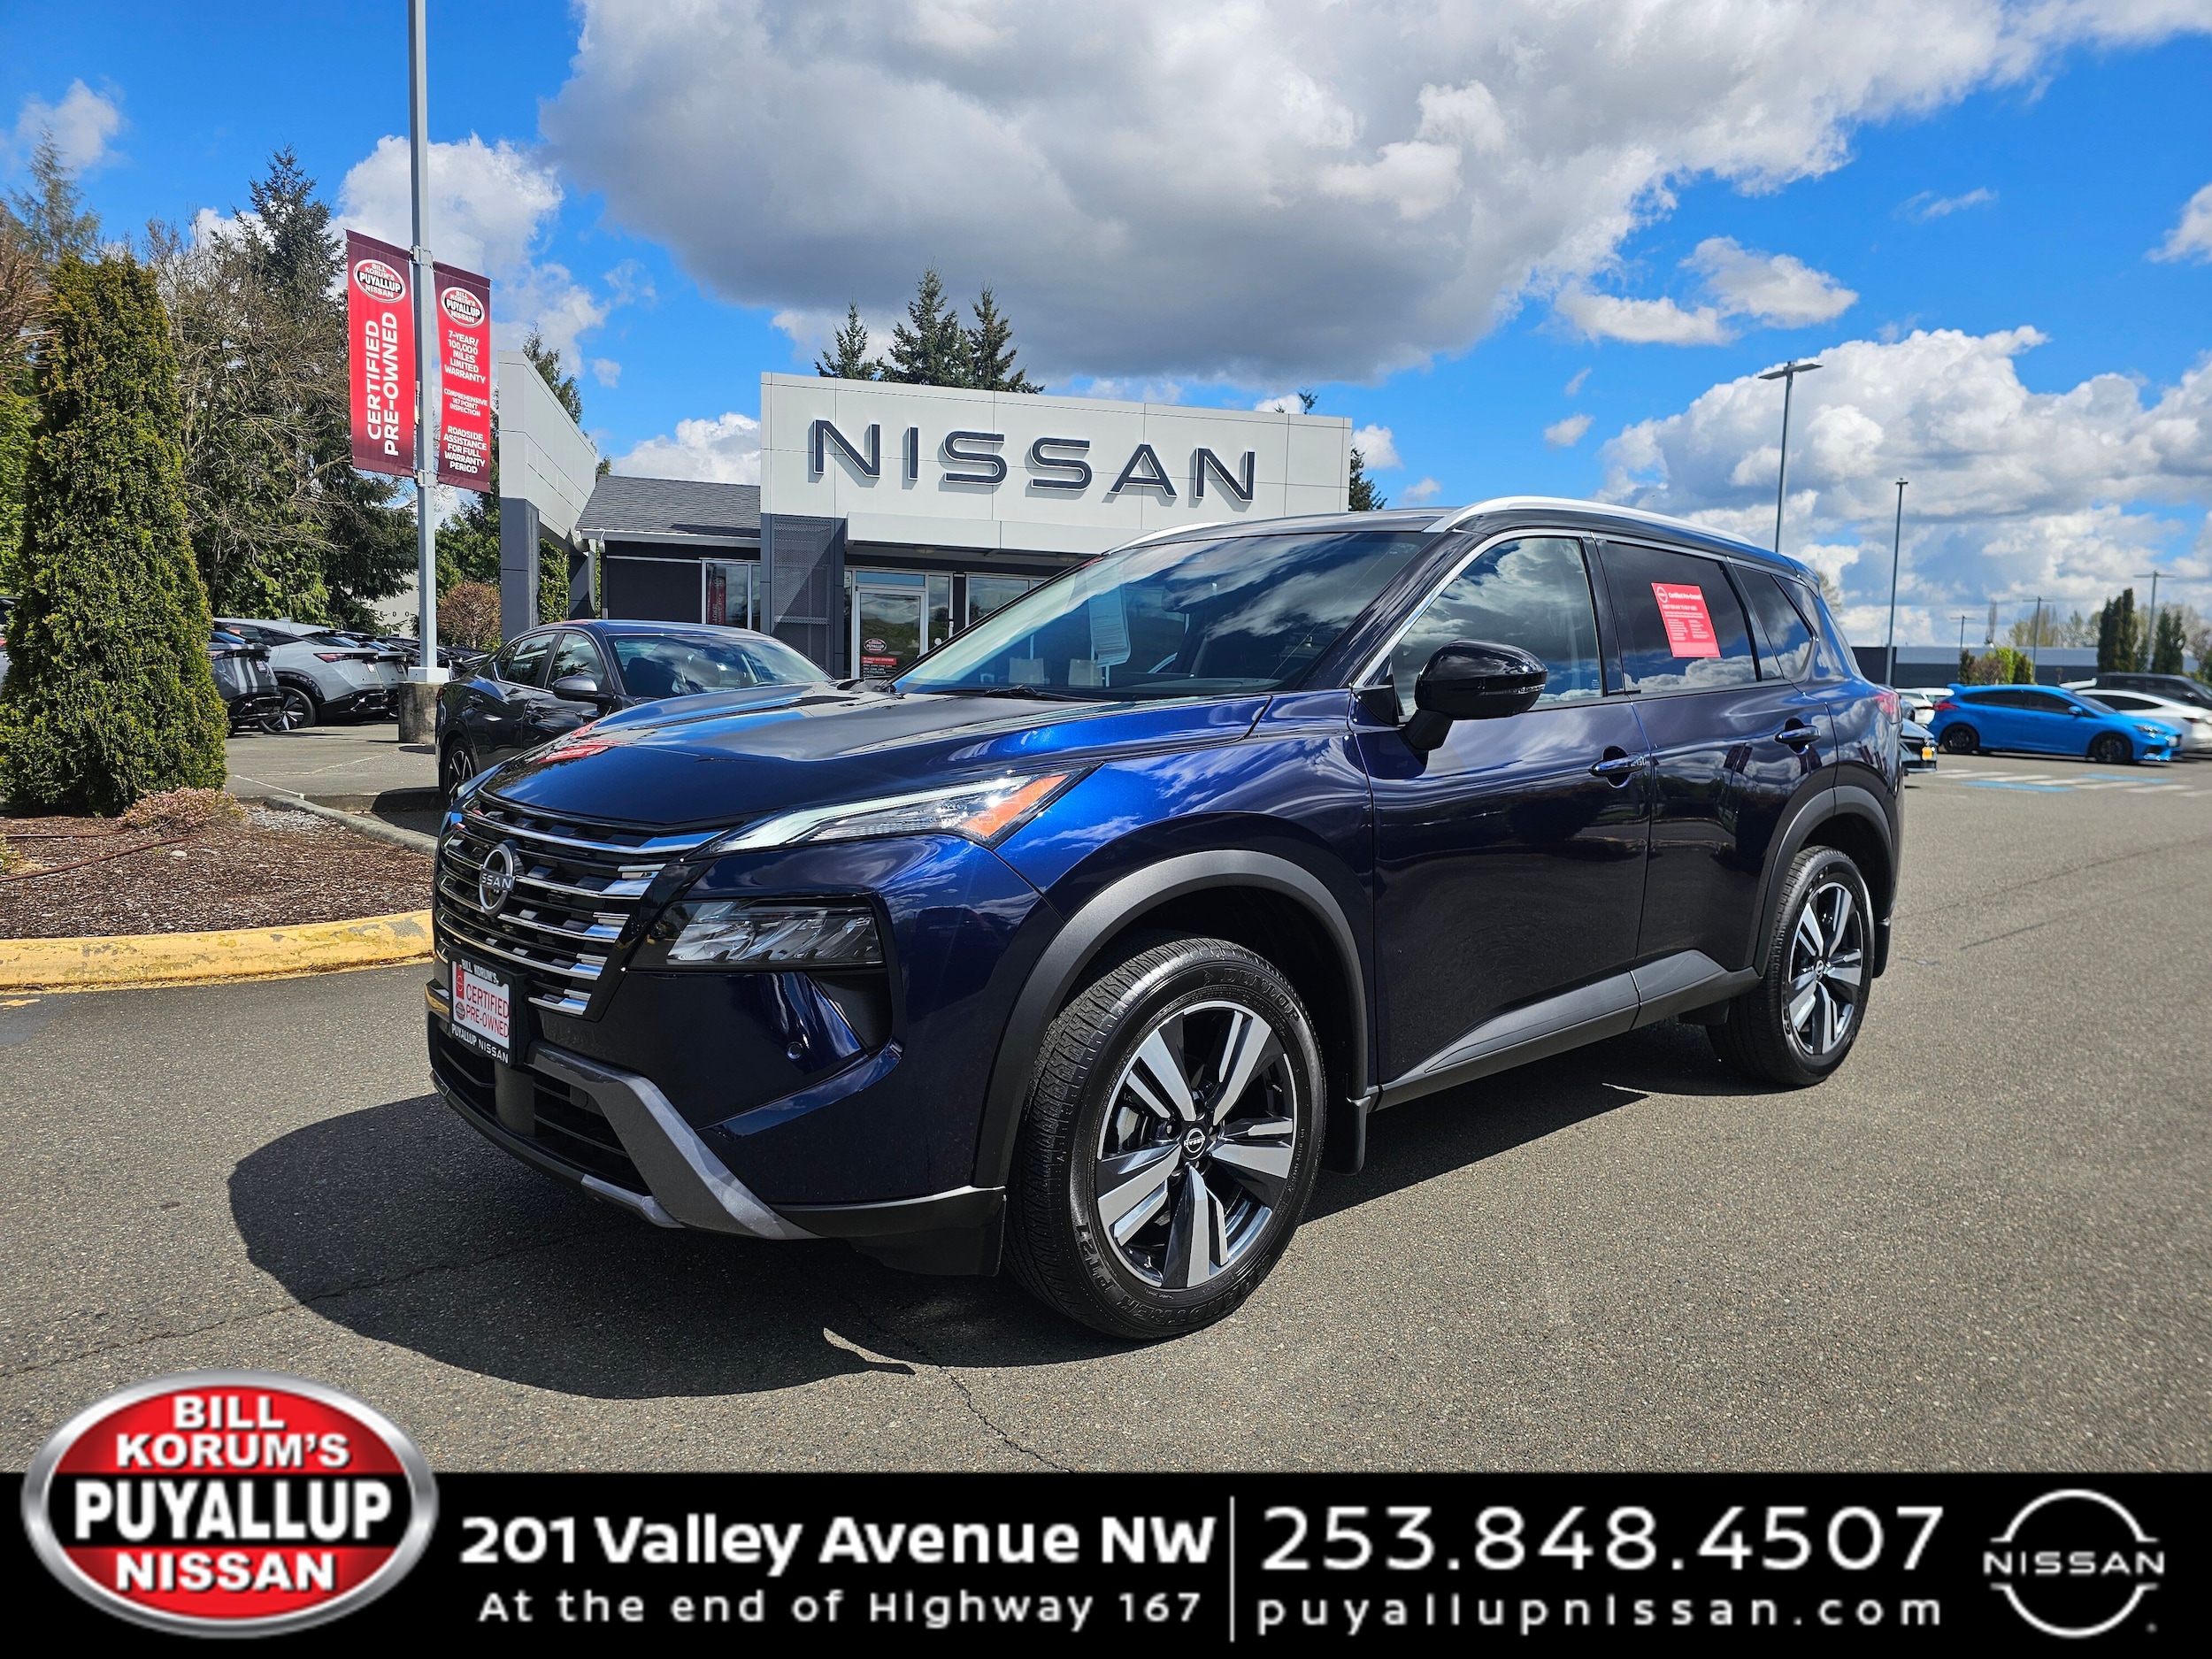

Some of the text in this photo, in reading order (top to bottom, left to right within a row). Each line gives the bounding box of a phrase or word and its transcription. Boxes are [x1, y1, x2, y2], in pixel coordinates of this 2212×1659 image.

[365, 266, 395, 280] KORUM'S
[372, 263, 387, 273] BILL
[359, 272, 402, 292] PUYALLUP
[365, 284, 394, 298] NISSAN
[456, 290, 469, 299] BILL
[449, 294, 476, 306] KORUM'S
[446, 299, 480, 318] PUYALLUP
[450, 311, 475, 323] NISSAN
[448, 330, 479, 347] 7-YEAR/
[448, 339, 479, 355] 100,000
[453, 349, 475, 364] MILES
[449, 357, 479, 373] LIMITED
[365, 320, 381, 441] CERTIFIED
[444, 365, 486, 384] WARRANTY
[382, 312, 399, 457] PRE-OWNED
[443, 388, 488, 406] COMPREHENSIVE
[460, 400, 478, 410] POINT
[449, 403, 480, 417] INSPECTION
[448, 426, 483, 442] ROADSIDE
[443, 434, 487, 451] ASSISTANCE
[448, 443, 481, 457] FOR FULL
[444, 451, 485, 467] WARRANTY
[812, 419, 1256, 503] NISSAN
[449, 461, 478, 474] PERIOD
[466, 983, 510, 1019] CERTIFIED
[466, 1004, 510, 1038] PRE-OWNED
[451, 1024, 509, 1064] PUYALLUP NISSAN
